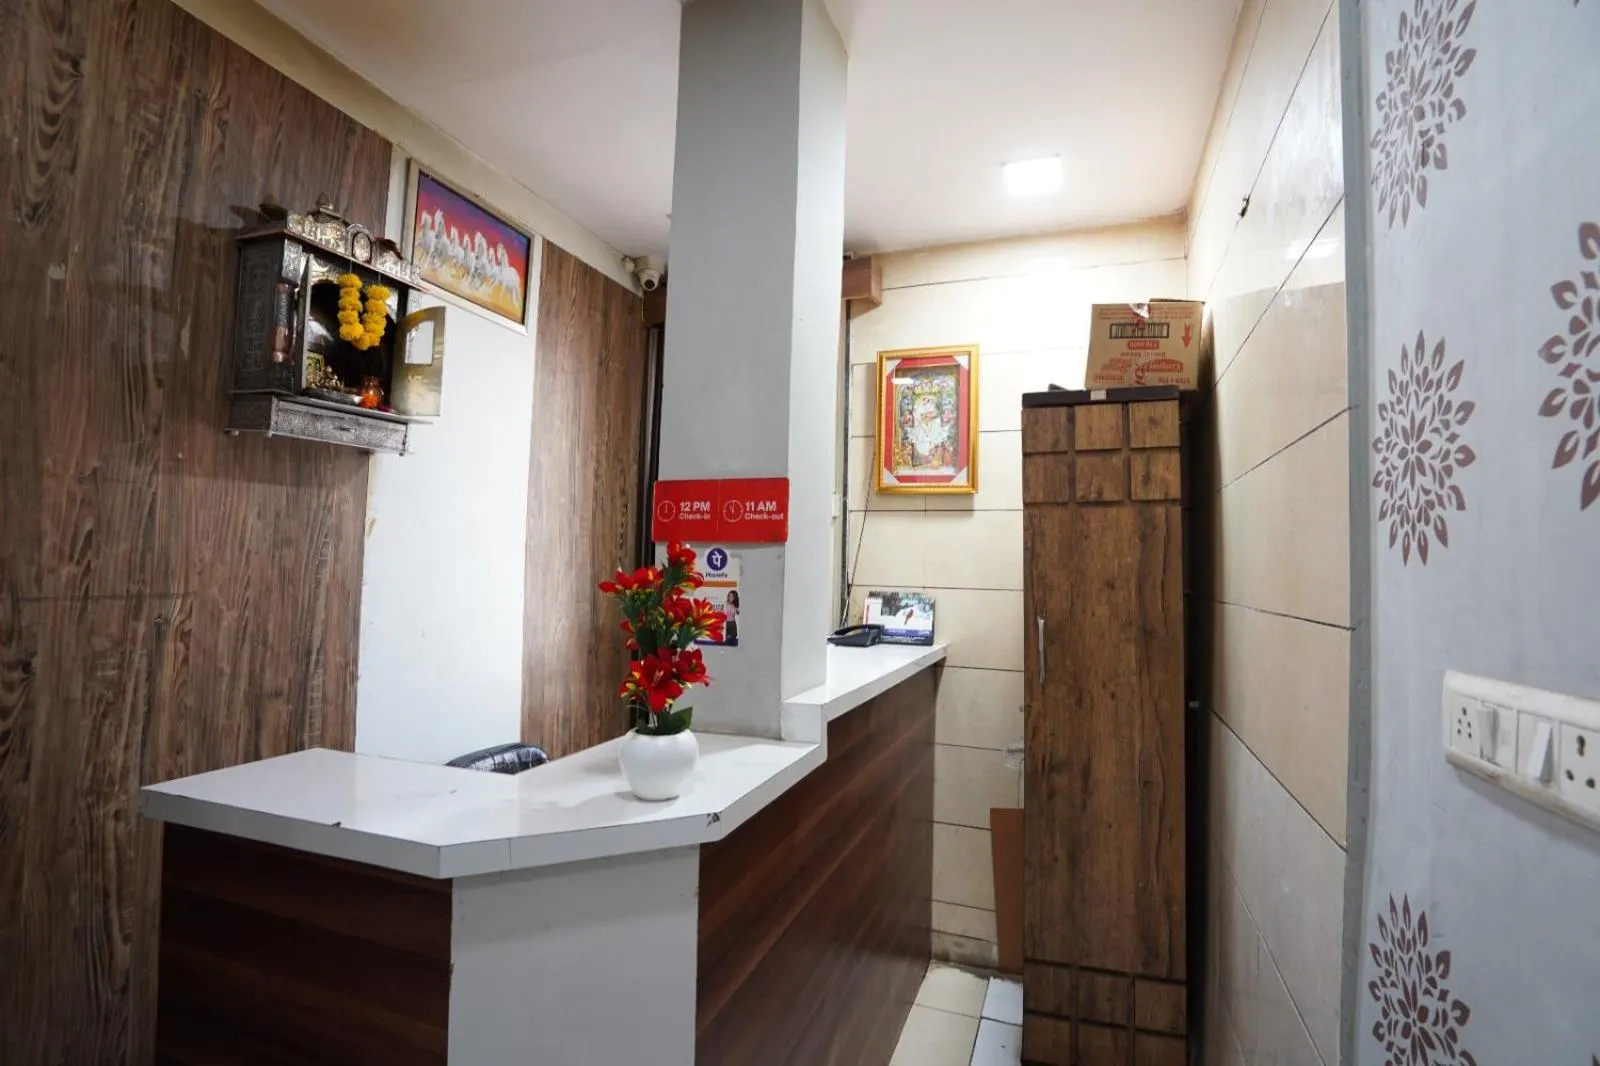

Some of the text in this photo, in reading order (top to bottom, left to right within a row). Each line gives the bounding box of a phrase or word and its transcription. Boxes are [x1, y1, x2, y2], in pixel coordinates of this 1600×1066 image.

[680, 501, 711, 512] 12 PM
[744, 501, 777, 512] 11 AM
[679, 512, 712, 521] Check-in
[744, 512, 785, 521] Check-out
